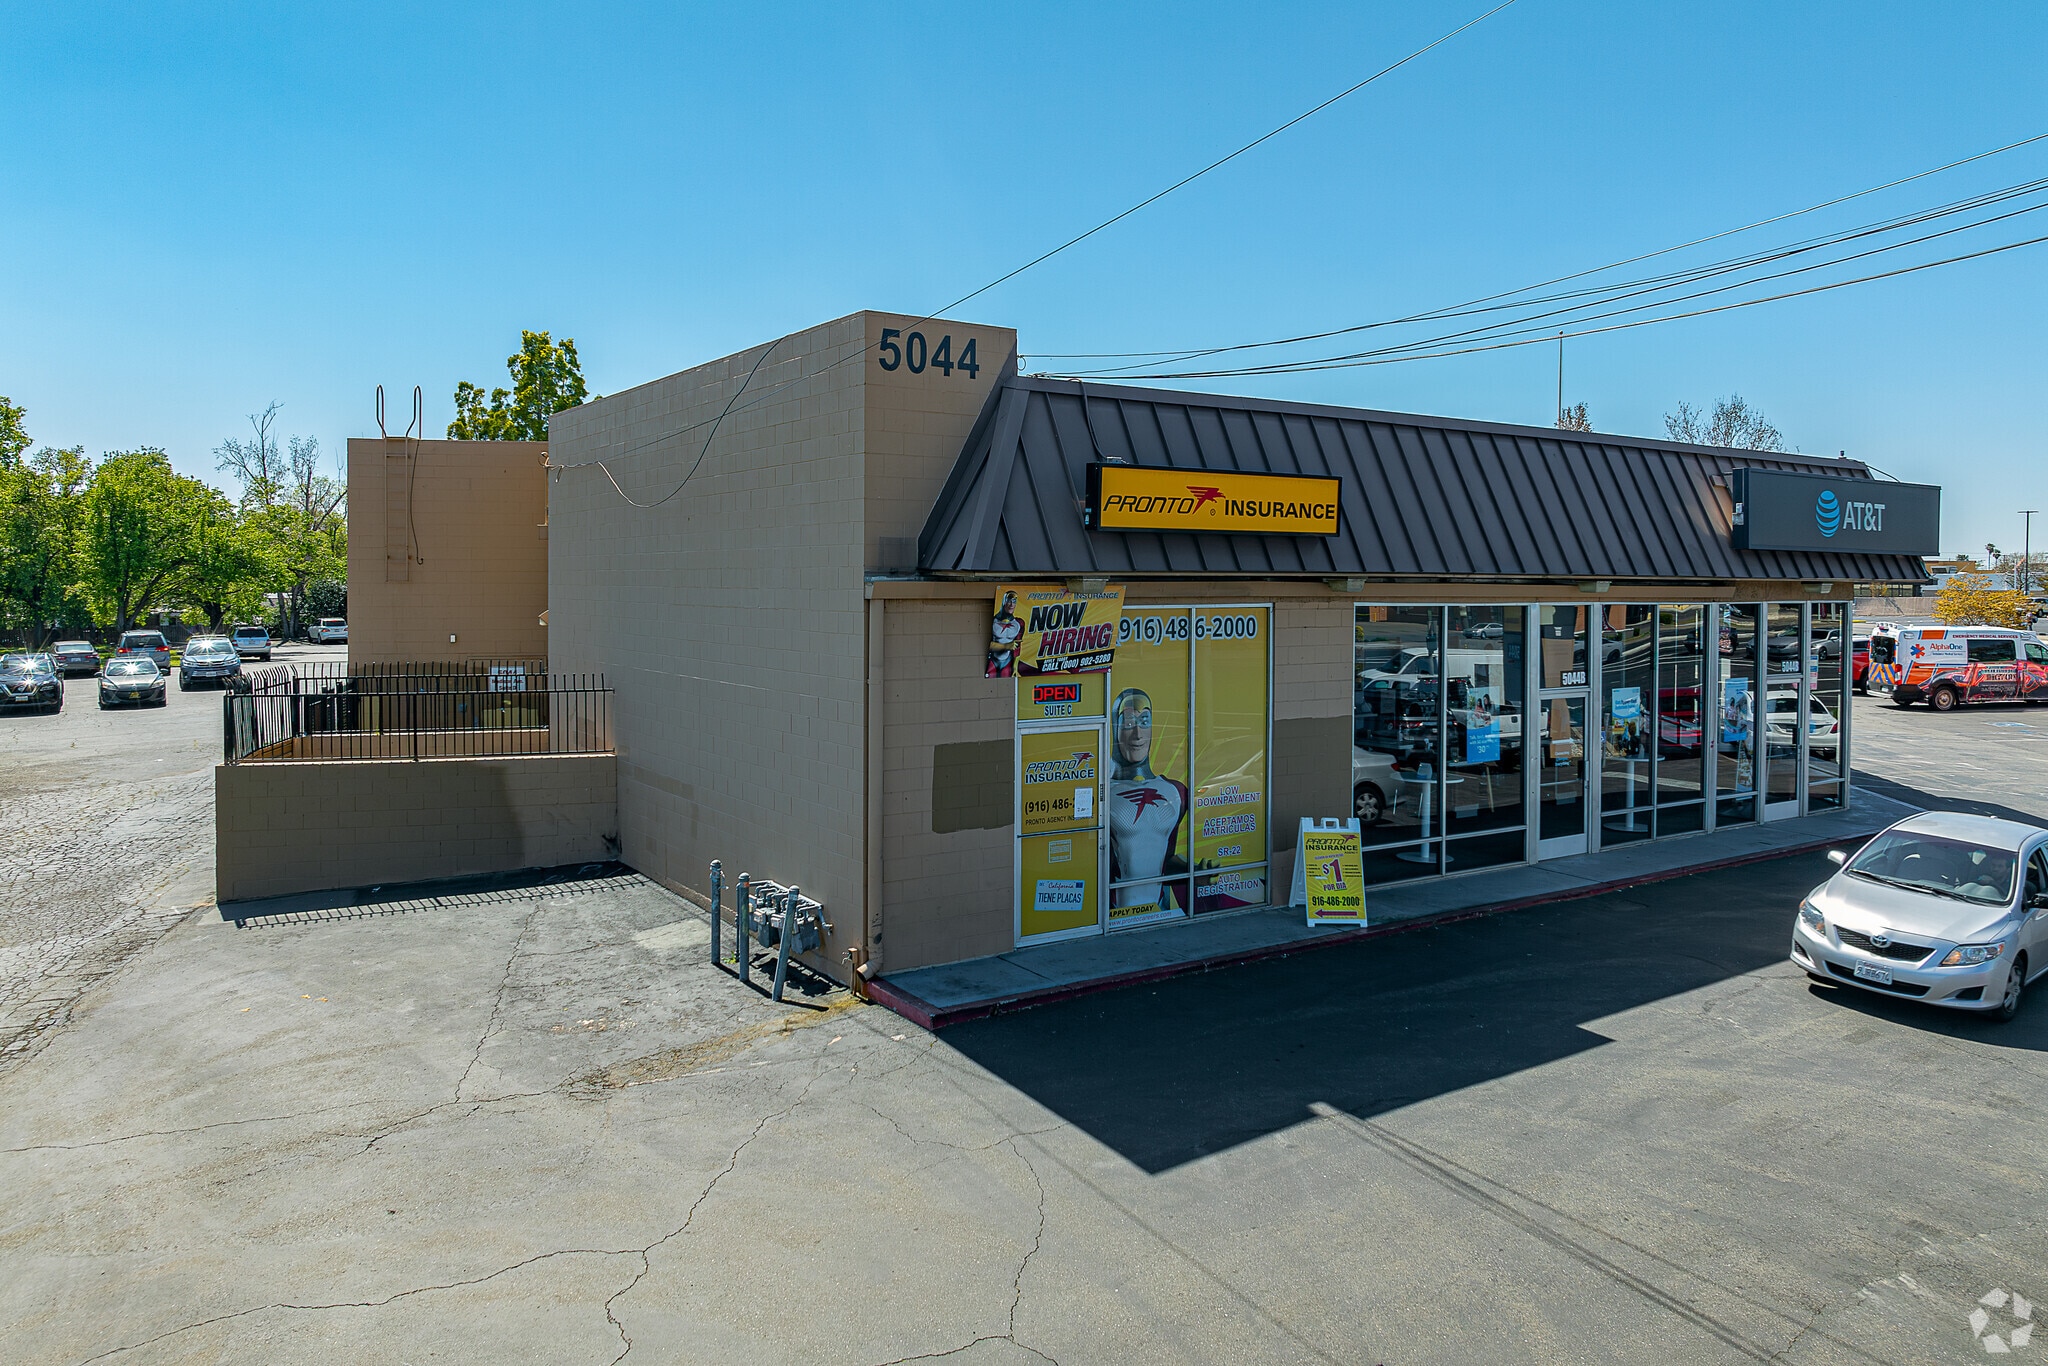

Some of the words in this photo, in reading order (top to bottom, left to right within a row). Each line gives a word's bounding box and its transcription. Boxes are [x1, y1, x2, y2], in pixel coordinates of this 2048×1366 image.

[878, 328, 980, 380] 5044
[1103, 495, 1194, 514] PRONTO
[1225, 499, 1336, 519] INSURANCE
[1843, 501, 1886, 532] AT&T
[1028, 600, 1088, 634] NOW
[1117, 615, 1258, 646] 916)486-2000
[1037, 622, 1114, 658] HIRING
[1930, 643, 1963, 651] AlphaOne
[1042, 662, 1059, 672] CALL
[1562, 671, 1586, 685] 5044B
[1032, 686, 1076, 701] OPEN
[1044, 704, 1065, 716] SUITE
[1067, 704, 1073, 716] C
[1026, 760, 1077, 774] PRONTO
[1025, 768, 1095, 784] INSURANCE
[1220, 785, 1240, 796] LOW
[1025, 799, 1050, 815] (916)
[1197, 792, 1261, 808] DOWNPAYMENT
[1026, 817, 1046, 826] PRONTO
[1047, 815, 1067, 824] AGENCY
[1204, 813, 1255, 828] ACEPTAMOS
[1203, 822, 1256, 837] MATRICULAS
[1217, 845, 1241, 858] SR-22
[1048, 882, 1074, 890] California
[1218, 873, 1241, 885] AUTO
[1197, 879, 1260, 897] REGISTRATION
[1038, 892, 1056, 903] TIENE
[1057, 892, 1082, 903] PLACAS
[1312, 895, 1360, 907] 916-486-2000
[1132, 905, 1154, 914] TODAY
